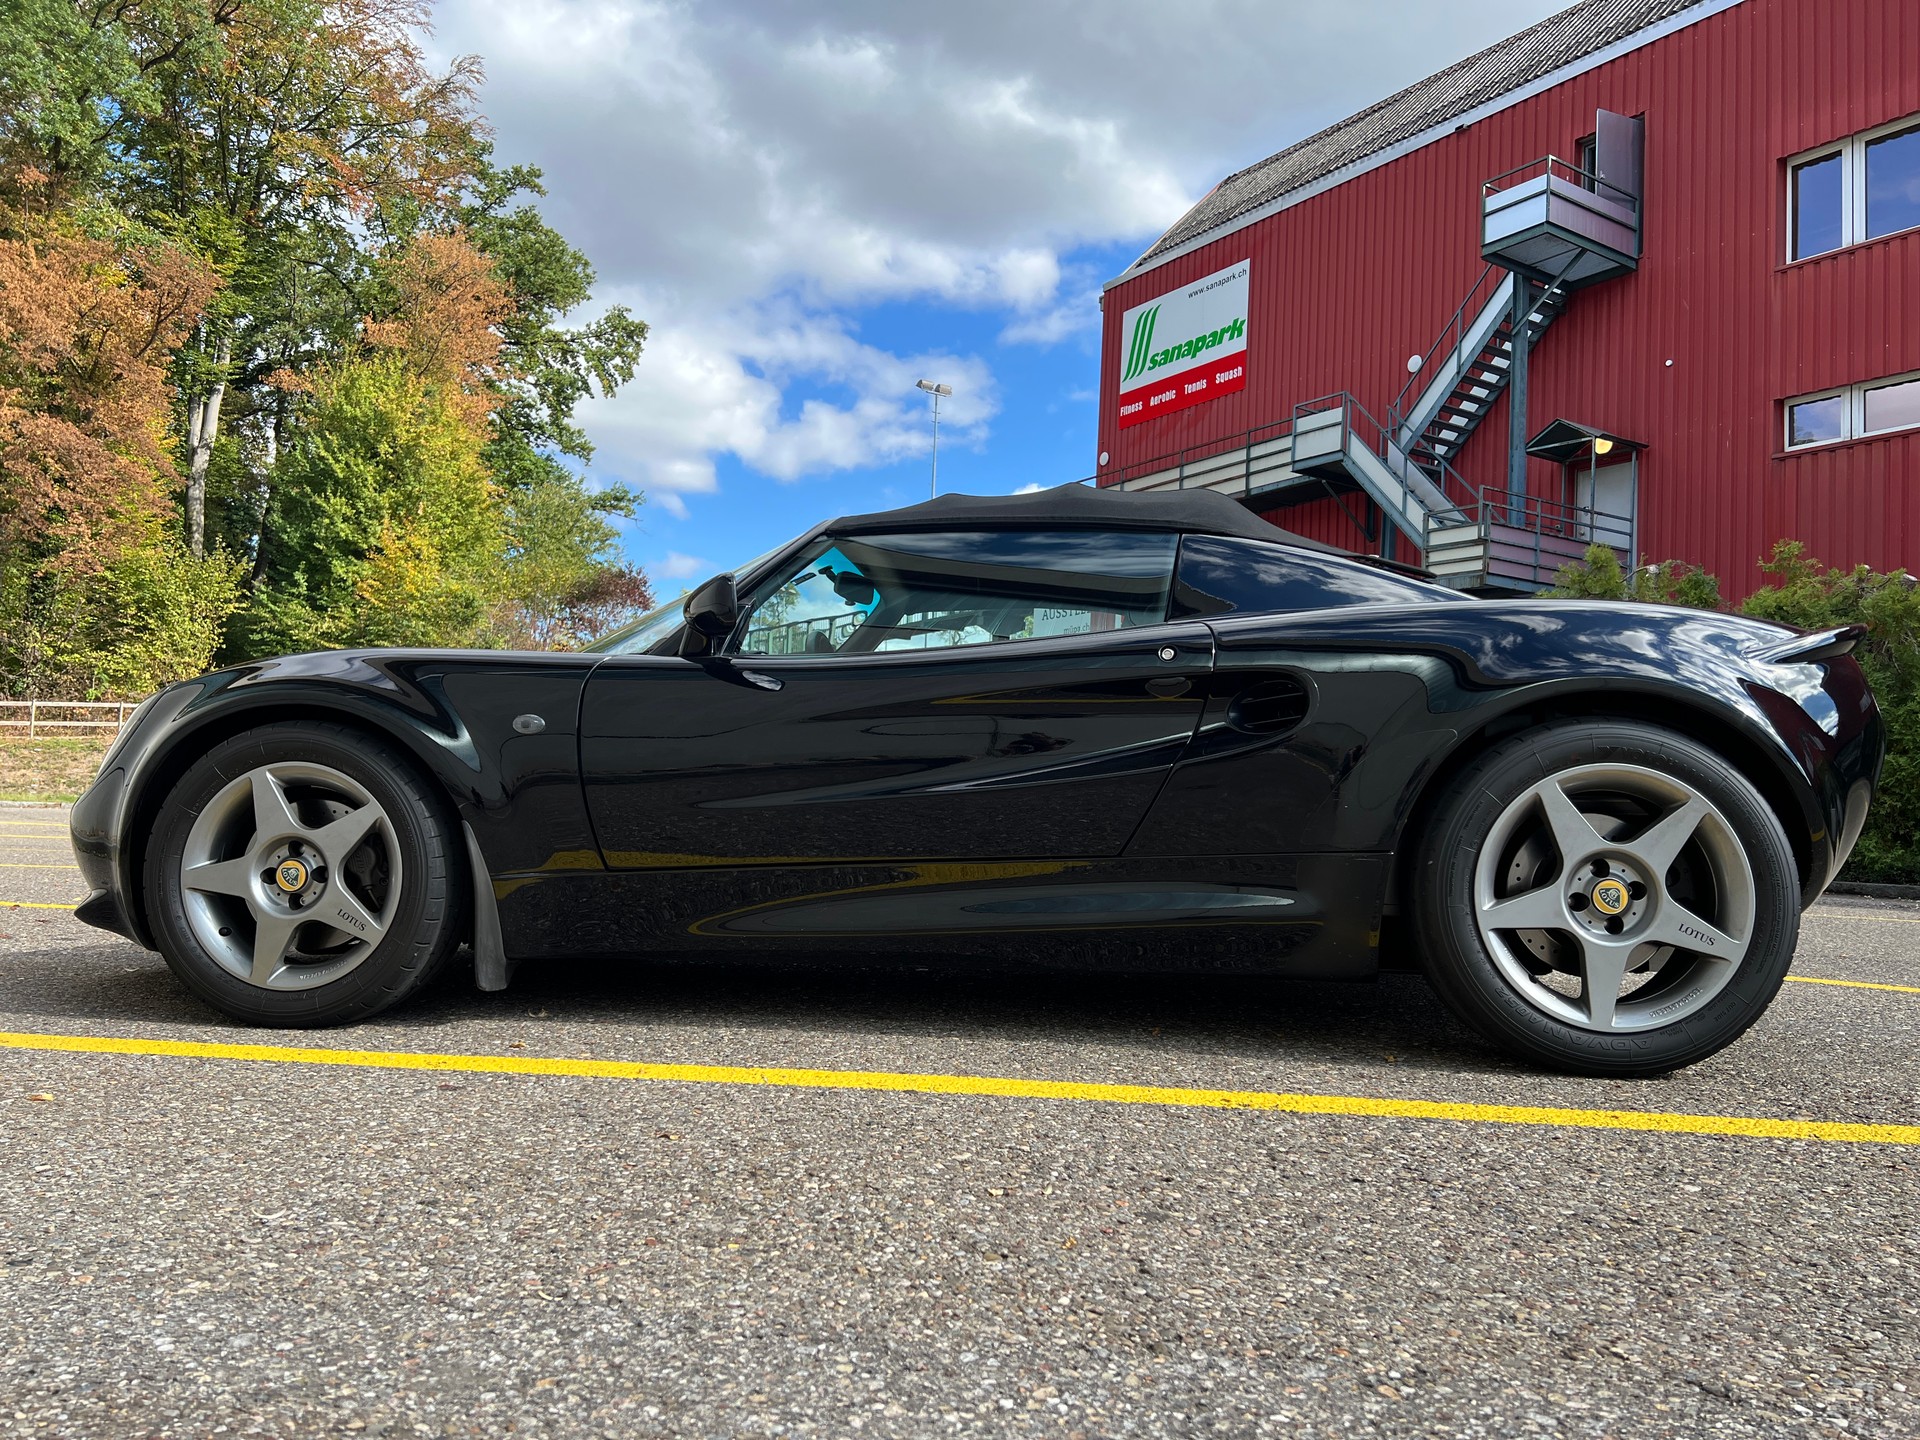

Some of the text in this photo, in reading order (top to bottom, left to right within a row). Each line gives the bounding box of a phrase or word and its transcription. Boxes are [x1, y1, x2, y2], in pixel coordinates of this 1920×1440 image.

[1187, 268, 1247, 299] www.sanapark.ch
[1147, 317, 1247, 371] sanapark
[1120, 366, 1243, 417] Fitness Aerobic Tennis Squash
[1041, 609, 1091, 621] AUSST
[281, 868, 299, 886] LOTUS
[1600, 889, 1620, 908] LOTUS
[337, 908, 367, 932] LOTUS
[1678, 923, 1716, 946] LOTUS
[1542, 1020, 1654, 1051] ADVAN
